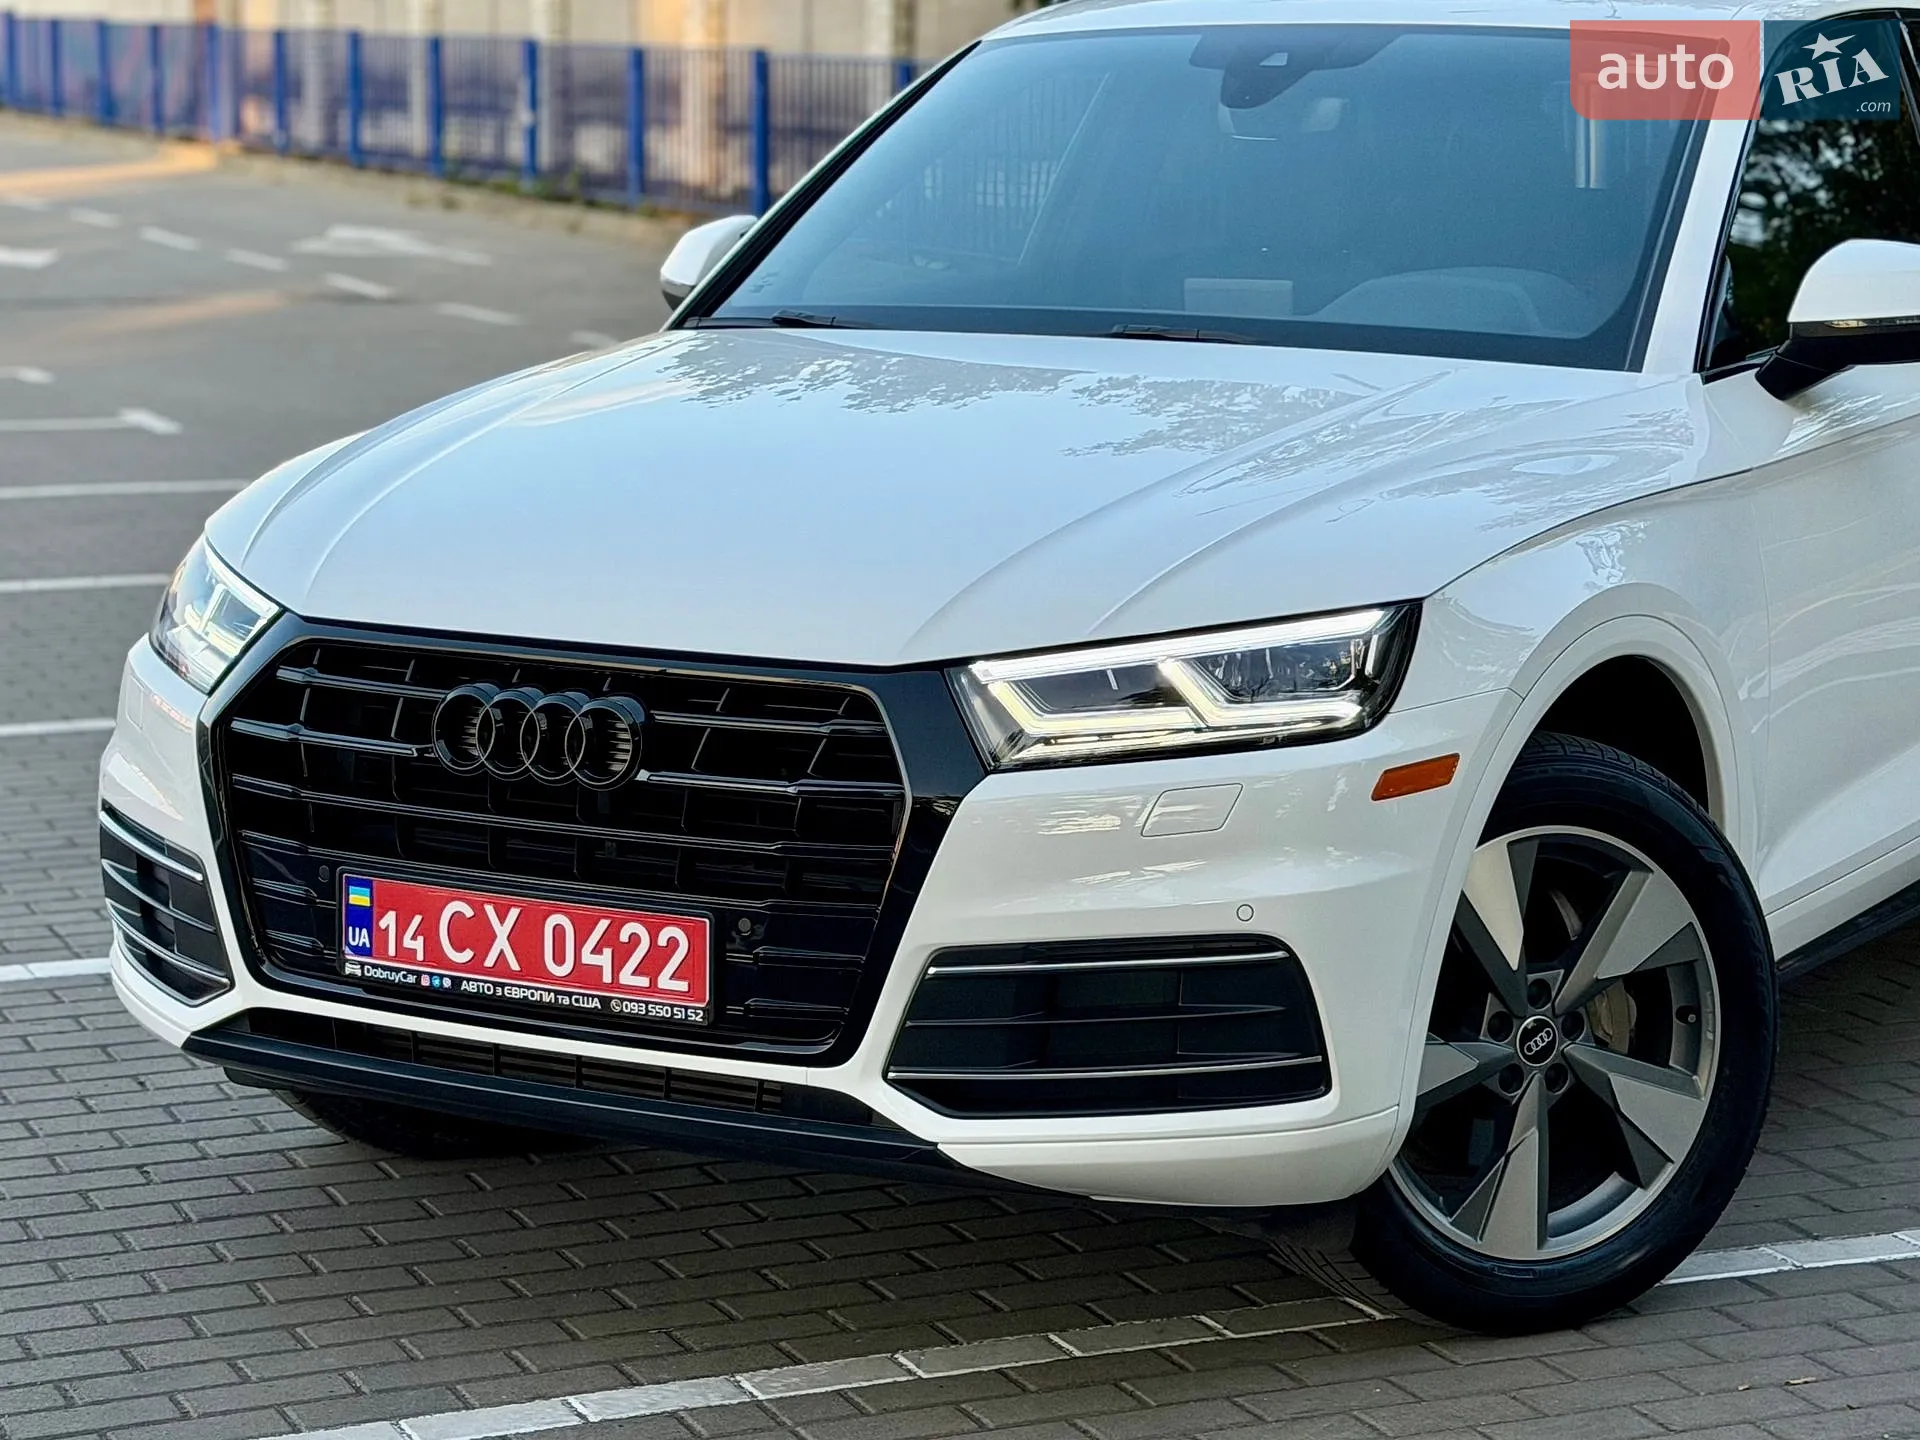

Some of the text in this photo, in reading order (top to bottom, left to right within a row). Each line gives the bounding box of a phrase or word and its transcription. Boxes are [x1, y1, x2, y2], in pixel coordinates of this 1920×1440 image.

[348, 926, 370, 948] UA
[377, 900, 690, 992] 14 CX 0422
[364, 965, 418, 984] DobruyCar
[460, 980, 494, 995] АВТО
[571, 995, 602, 1009] США
[622, 1001, 704, 1022] 093 550 51 52
